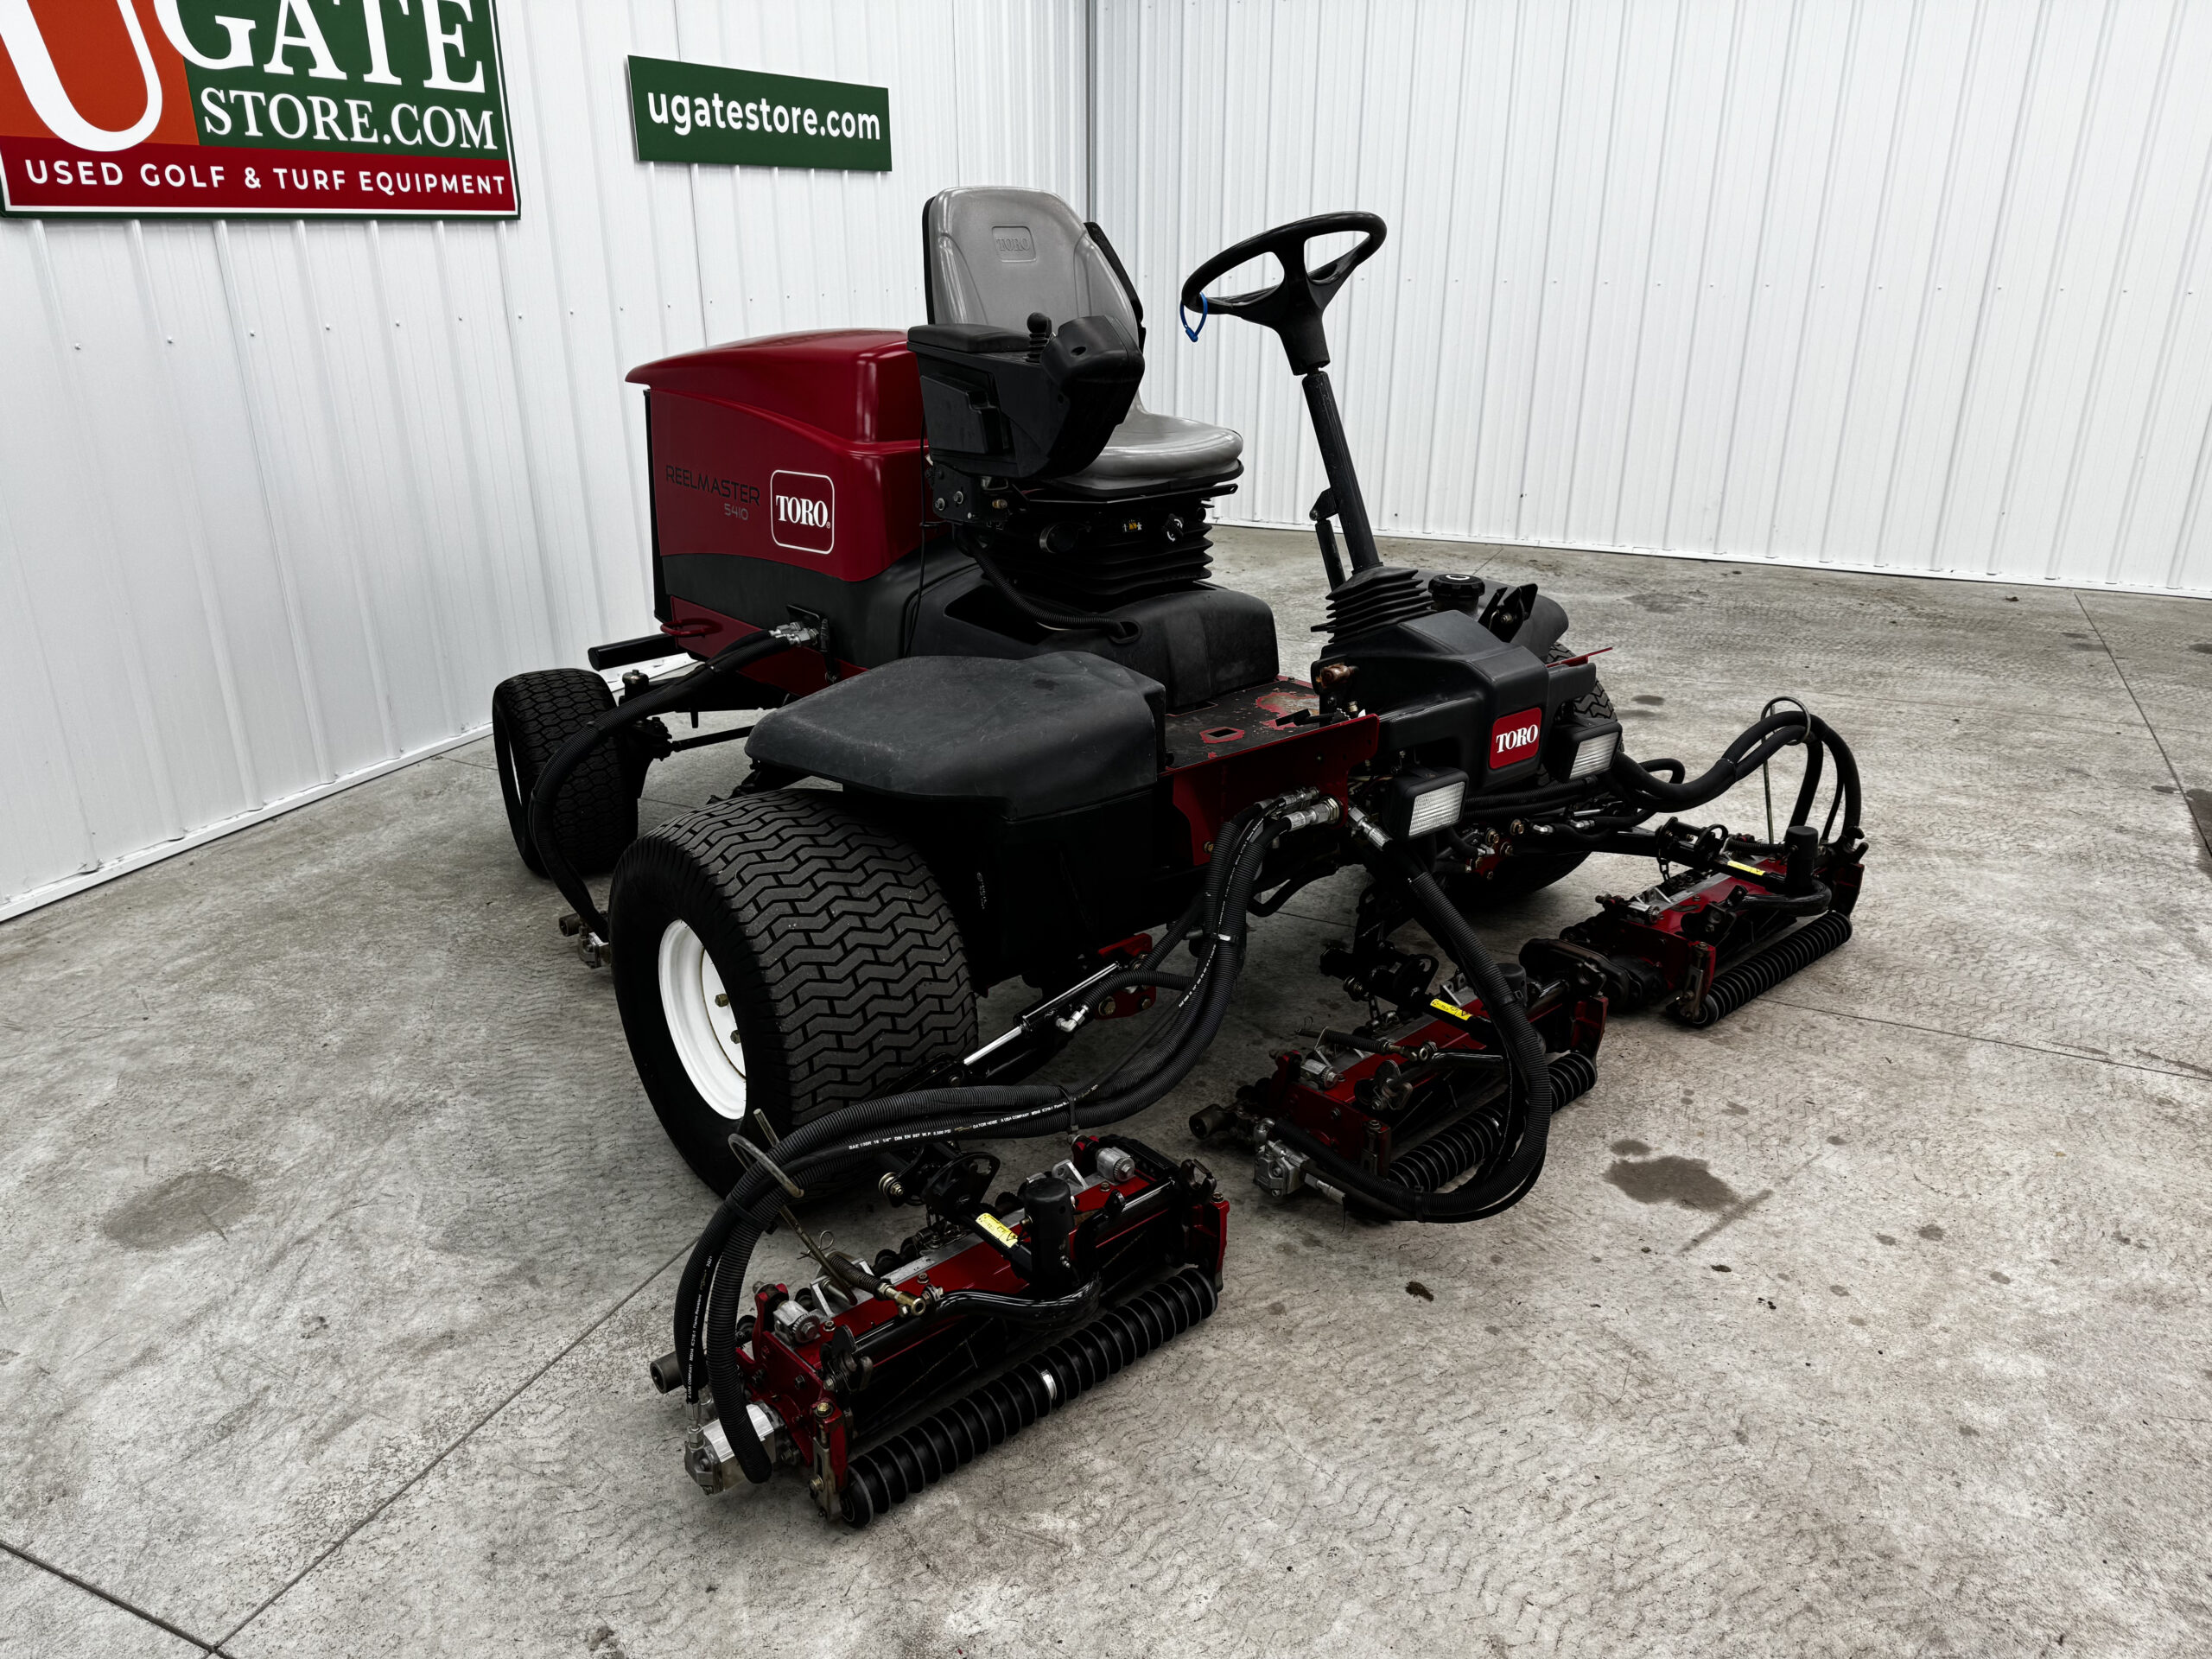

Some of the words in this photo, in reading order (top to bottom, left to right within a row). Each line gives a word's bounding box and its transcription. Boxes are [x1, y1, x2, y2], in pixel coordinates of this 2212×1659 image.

[200, 86, 499, 150] STORE.COM
[647, 92, 880, 140] ugatestore.com
[25, 159, 124, 186] USED
[140, 162, 225, 188] GOLF
[245, 167, 262, 189] &
[272, 168, 346, 191] TURF
[359, 170, 505, 196] EQUIPMENT
[995, 237, 1030, 251] TORO
[665, 465, 760, 506] REELMASTER
[724, 503, 749, 520] 5410
[1496, 724, 1539, 753] TORO
